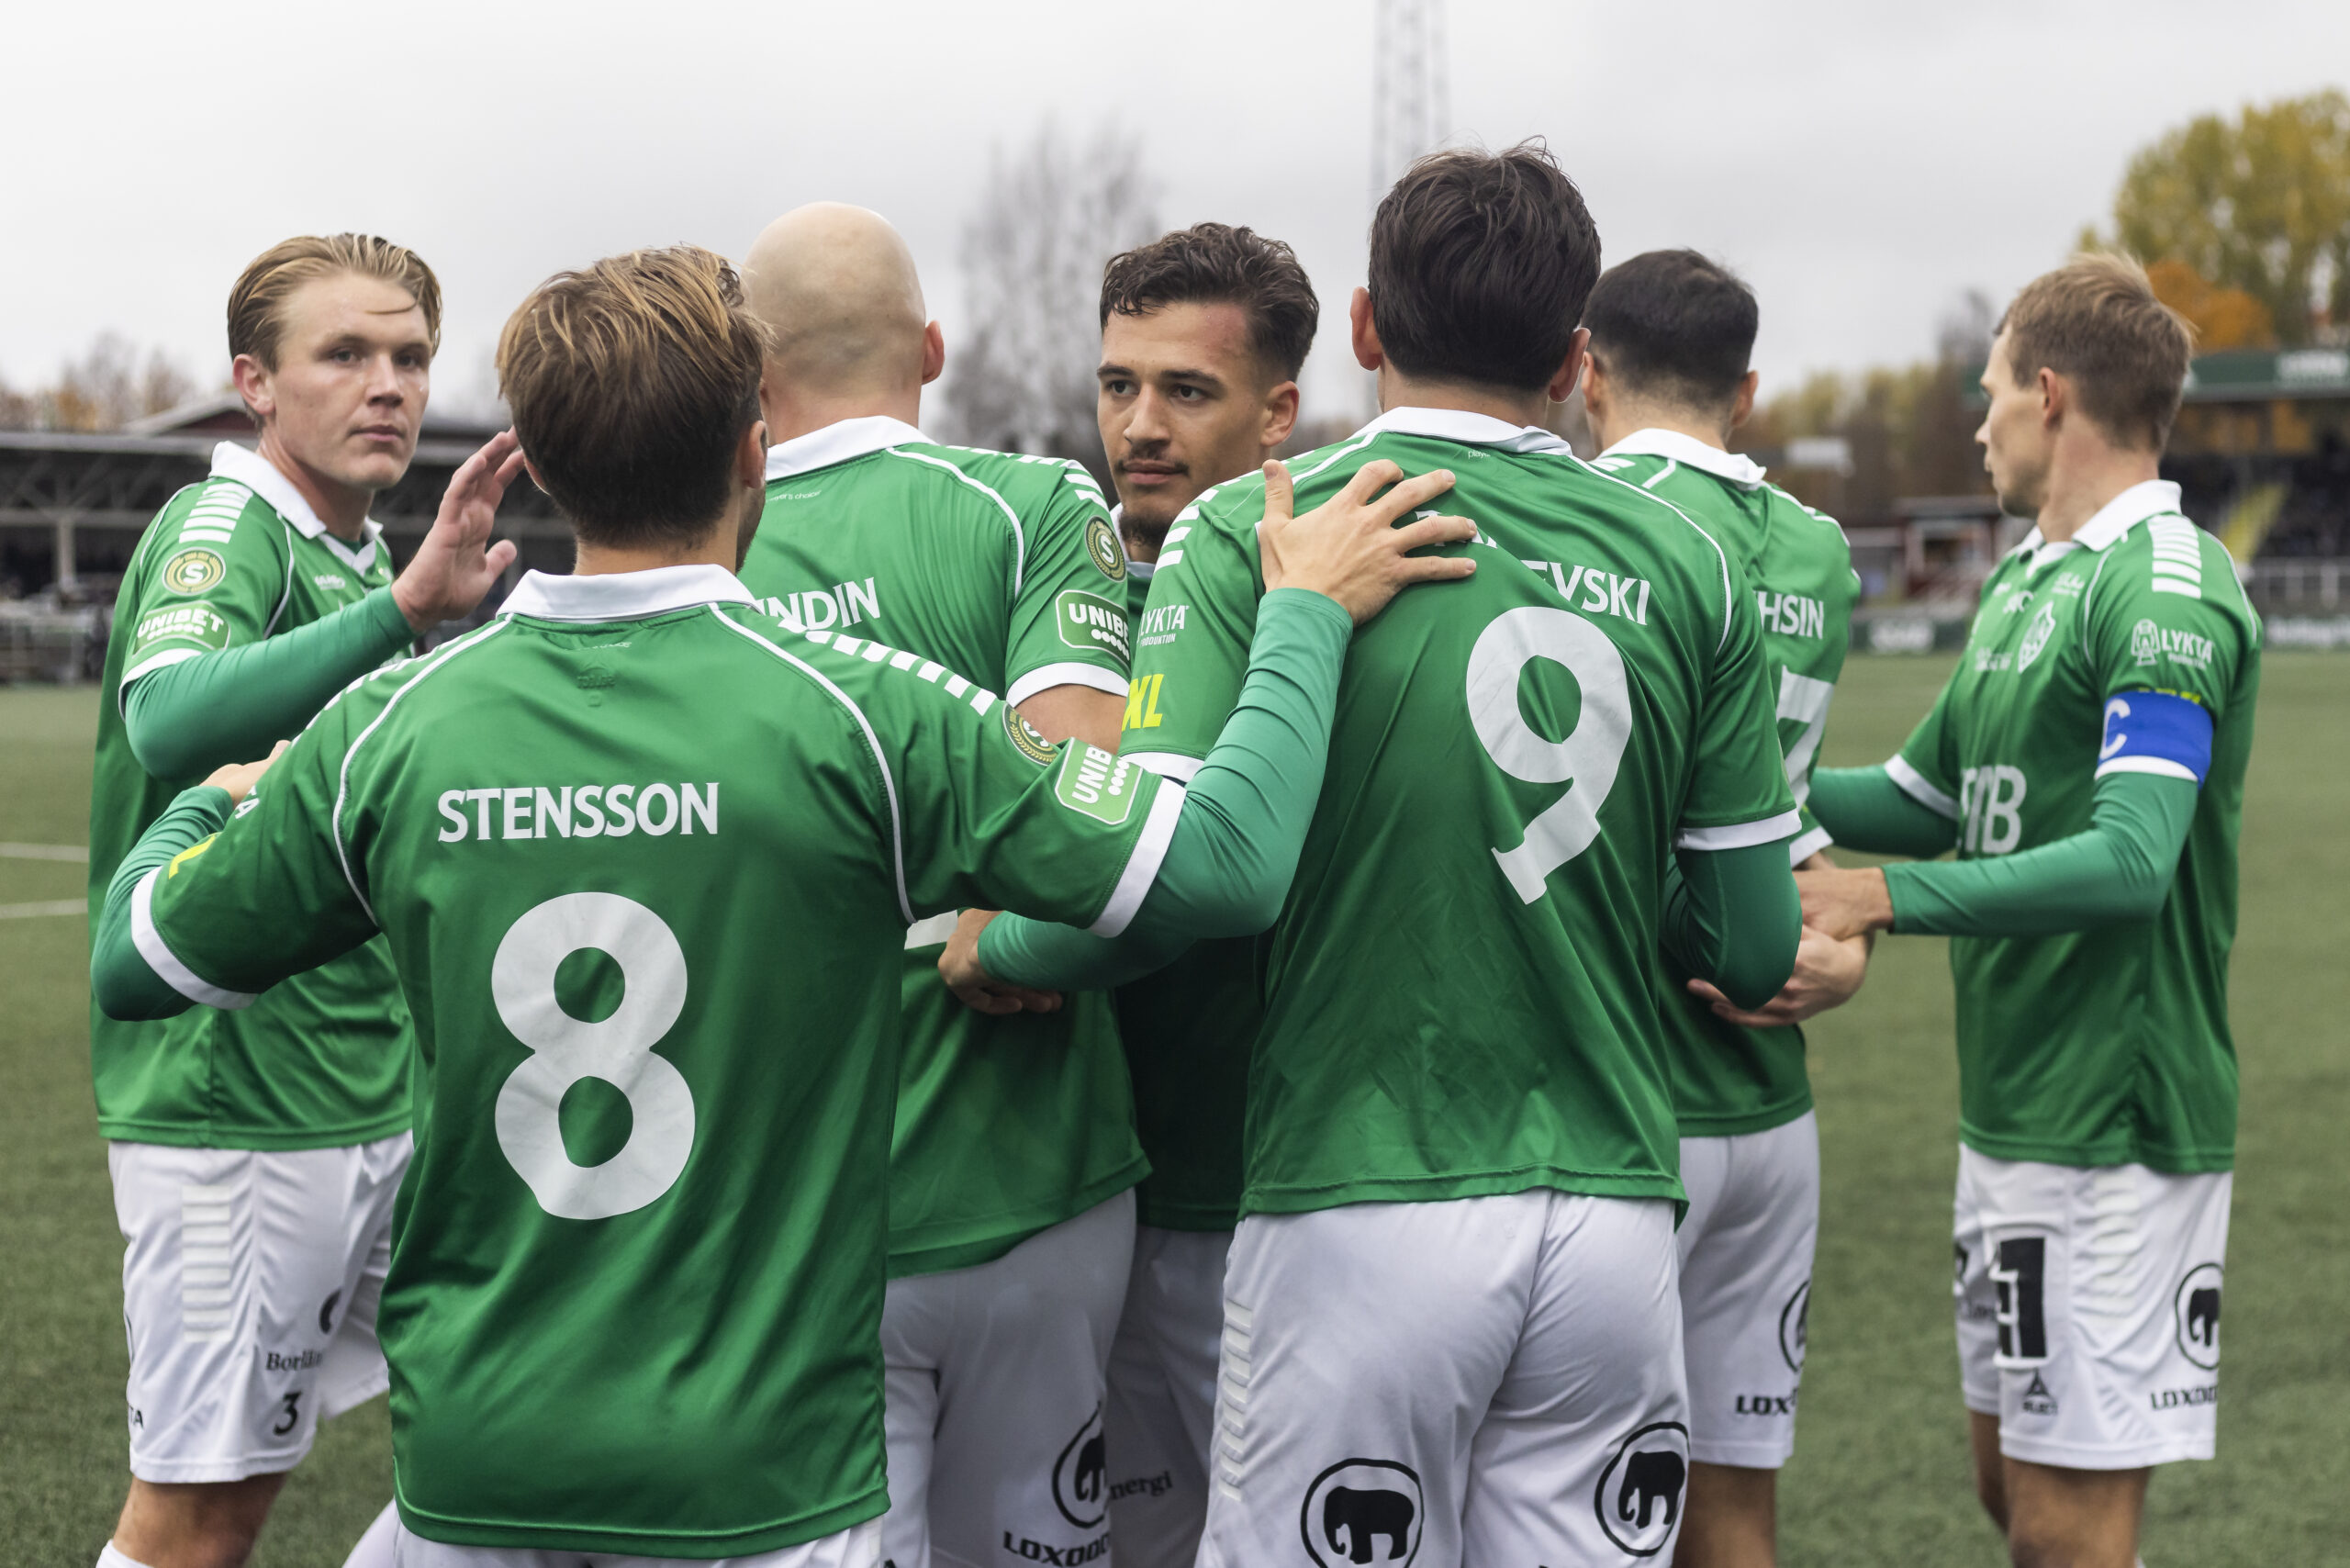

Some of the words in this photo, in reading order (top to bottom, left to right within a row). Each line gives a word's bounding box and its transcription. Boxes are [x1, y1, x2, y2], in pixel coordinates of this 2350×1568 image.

[137, 608, 225, 639] UNIBET
[1138, 604, 1186, 637] LYKTA
[2161, 628, 2213, 664] LYKTA
[1121, 673, 1165, 732] XL
[2099, 698, 2132, 760] C
[1466, 606, 1632, 905] 9
[437, 782, 720, 843] STENSSON
[491, 891, 696, 1221] 8
[273, 1390, 304, 1437] 3
